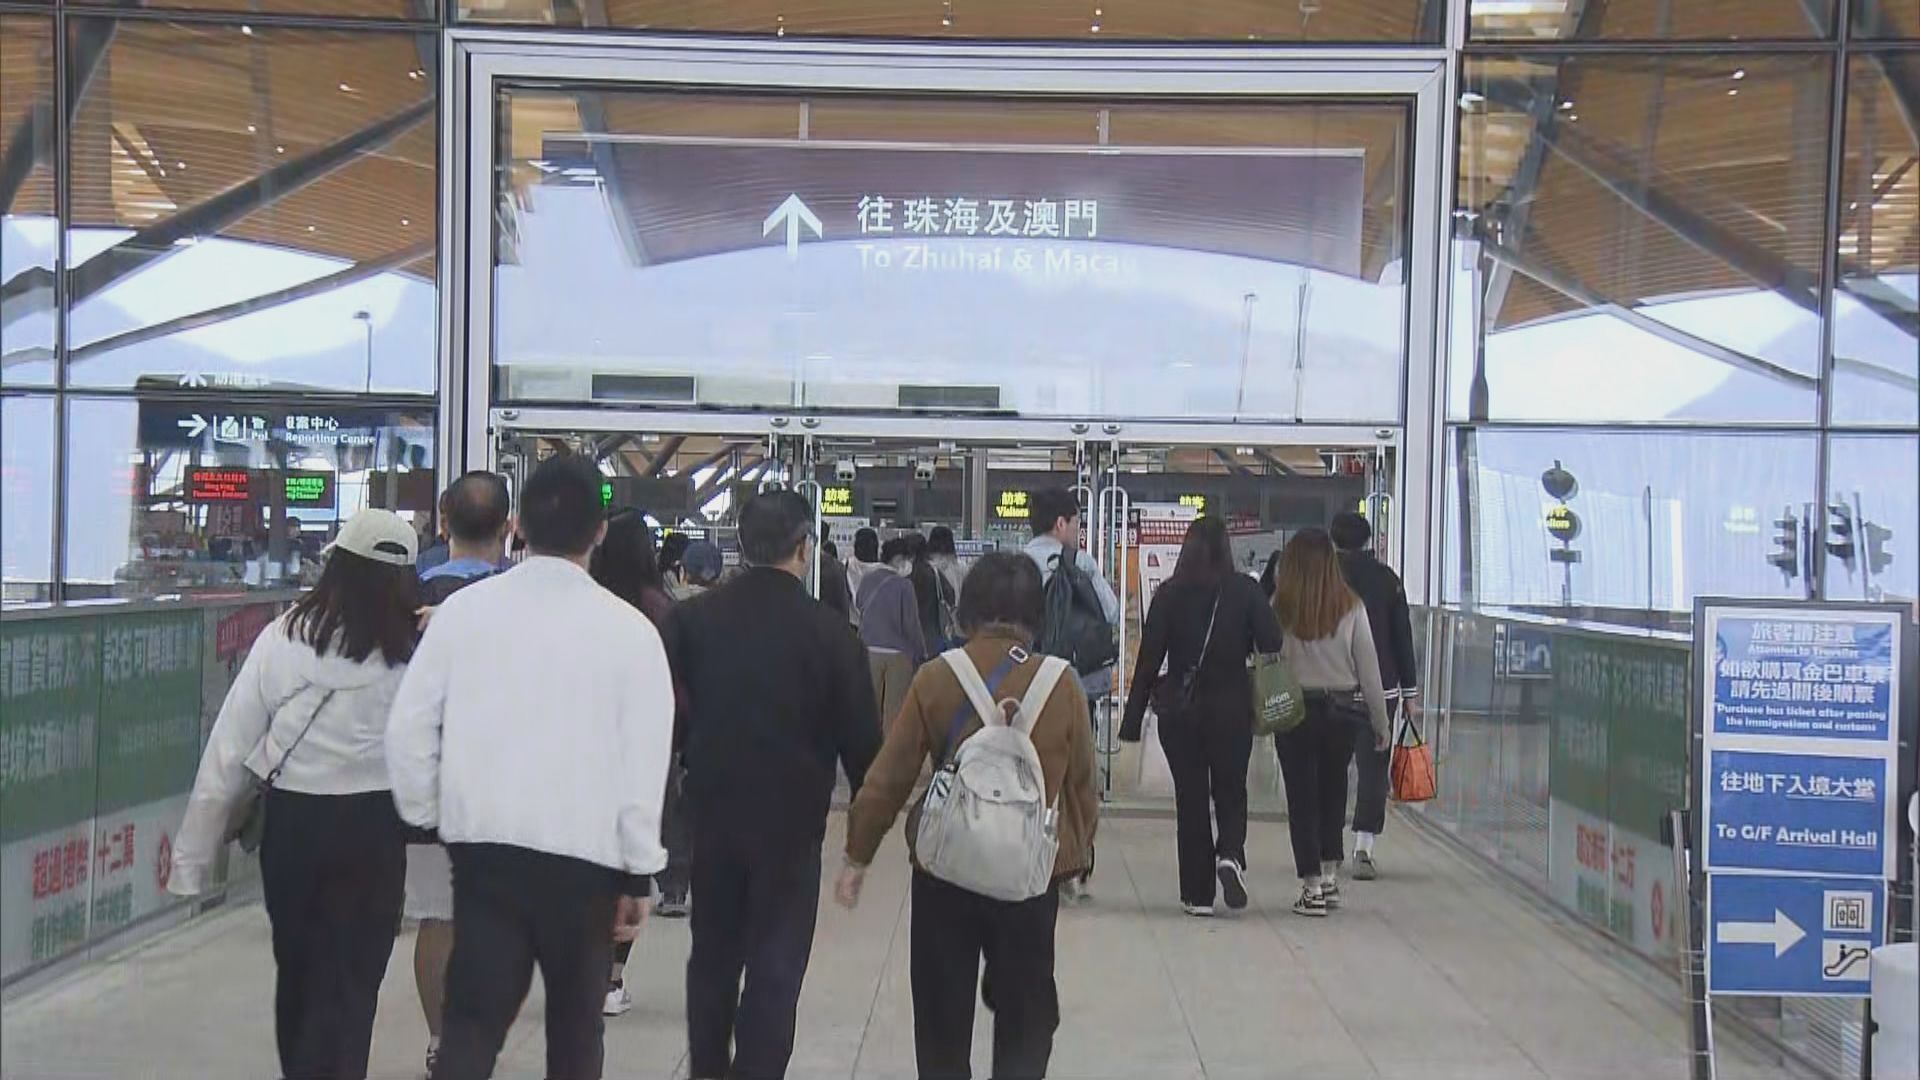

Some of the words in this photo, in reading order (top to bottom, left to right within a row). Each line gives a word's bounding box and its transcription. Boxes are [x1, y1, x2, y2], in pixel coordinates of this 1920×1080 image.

[857, 245, 891, 268] To
[903, 244, 999, 269] Zhuhai
[1012, 248, 1033, 271] &
[285, 431, 338, 446] Reporting
[821, 503, 852, 514] Visitors
[996, 506, 1029, 517] Visitors
[1717, 703, 1764, 715] Purchase
[1766, 705, 1784, 716] bus
[1786, 705, 1817, 718] ticket
[1818, 707, 1845, 719] after
[1726, 715, 1743, 726] the
[1812, 719, 1832, 730] and
[1720, 771, 1876, 798] 往地下入境大堂
[1716, 824, 1737, 838] To
[1741, 825, 1773, 842] G/F
[1776, 826, 1836, 844] Arrival
[1841, 829, 1877, 846] Hall
